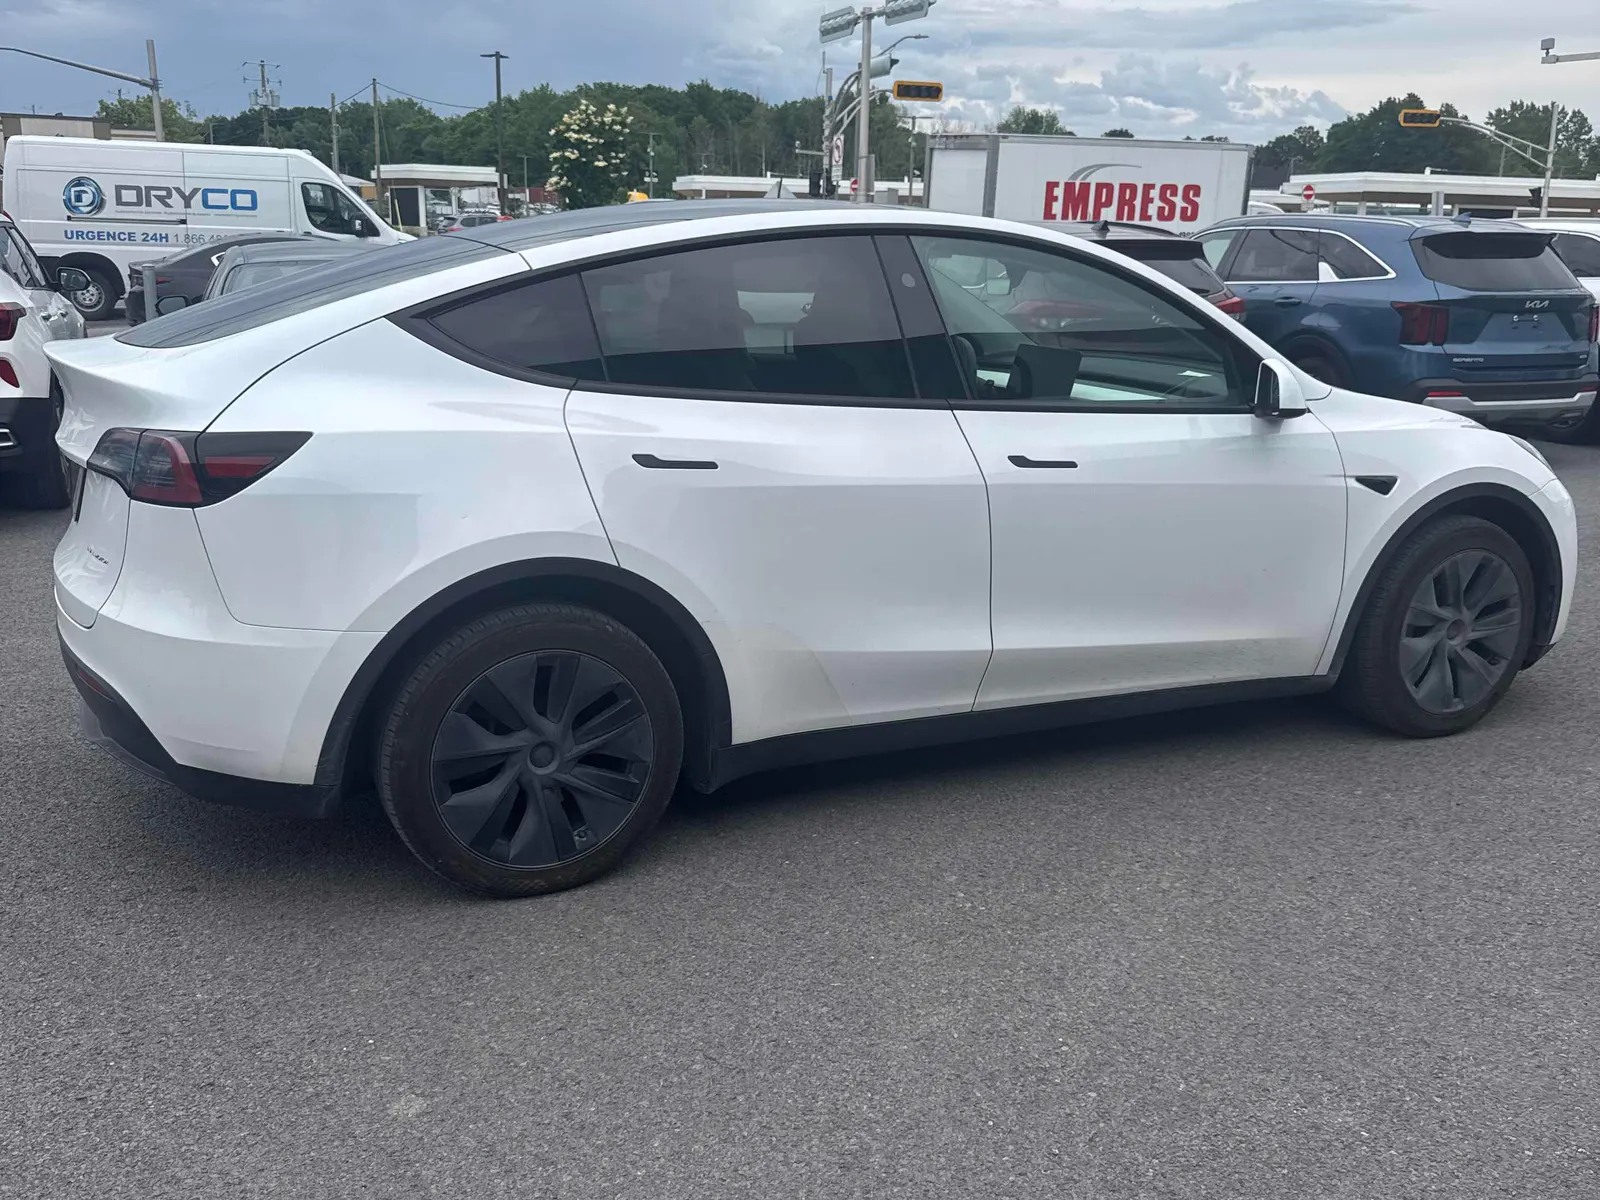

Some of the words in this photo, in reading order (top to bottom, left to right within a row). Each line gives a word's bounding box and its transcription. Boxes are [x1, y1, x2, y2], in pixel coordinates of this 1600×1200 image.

[114, 184, 258, 211] DRYCO
[1043, 181, 1201, 222] EMPRESS
[64, 229, 137, 242] URGENCE
[141, 232, 169, 243] 24H
[1525, 300, 1550, 308] KIA
